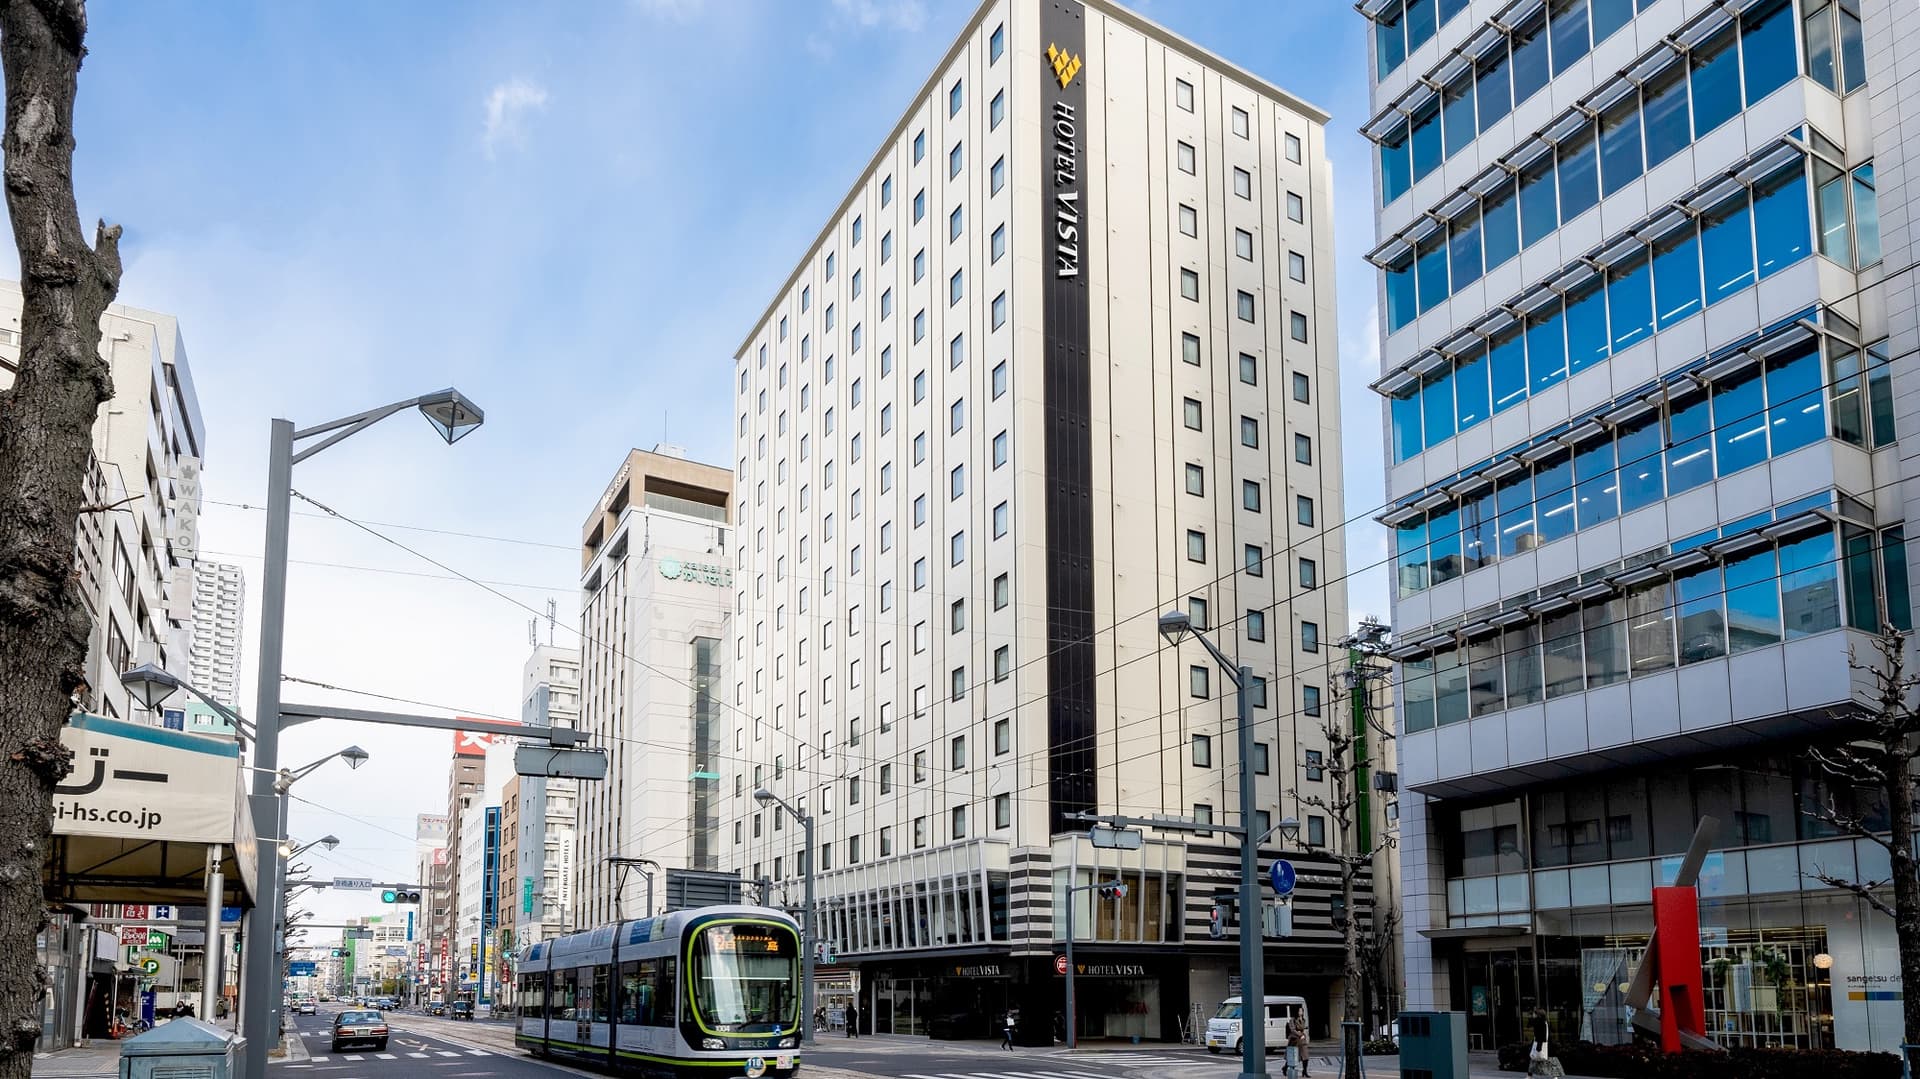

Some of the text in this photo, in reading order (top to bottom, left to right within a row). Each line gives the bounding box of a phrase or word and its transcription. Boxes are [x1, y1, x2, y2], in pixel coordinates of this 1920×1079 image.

[1056, 101, 1079, 277] HOTEL VISTA
[179, 485, 195, 547] WAKO
[962, 965, 1000, 976] HOTEL VISTA
[1088, 965, 1144, 975] HOTEL VISTA
[1847, 975, 1887, 984] sangetsu
